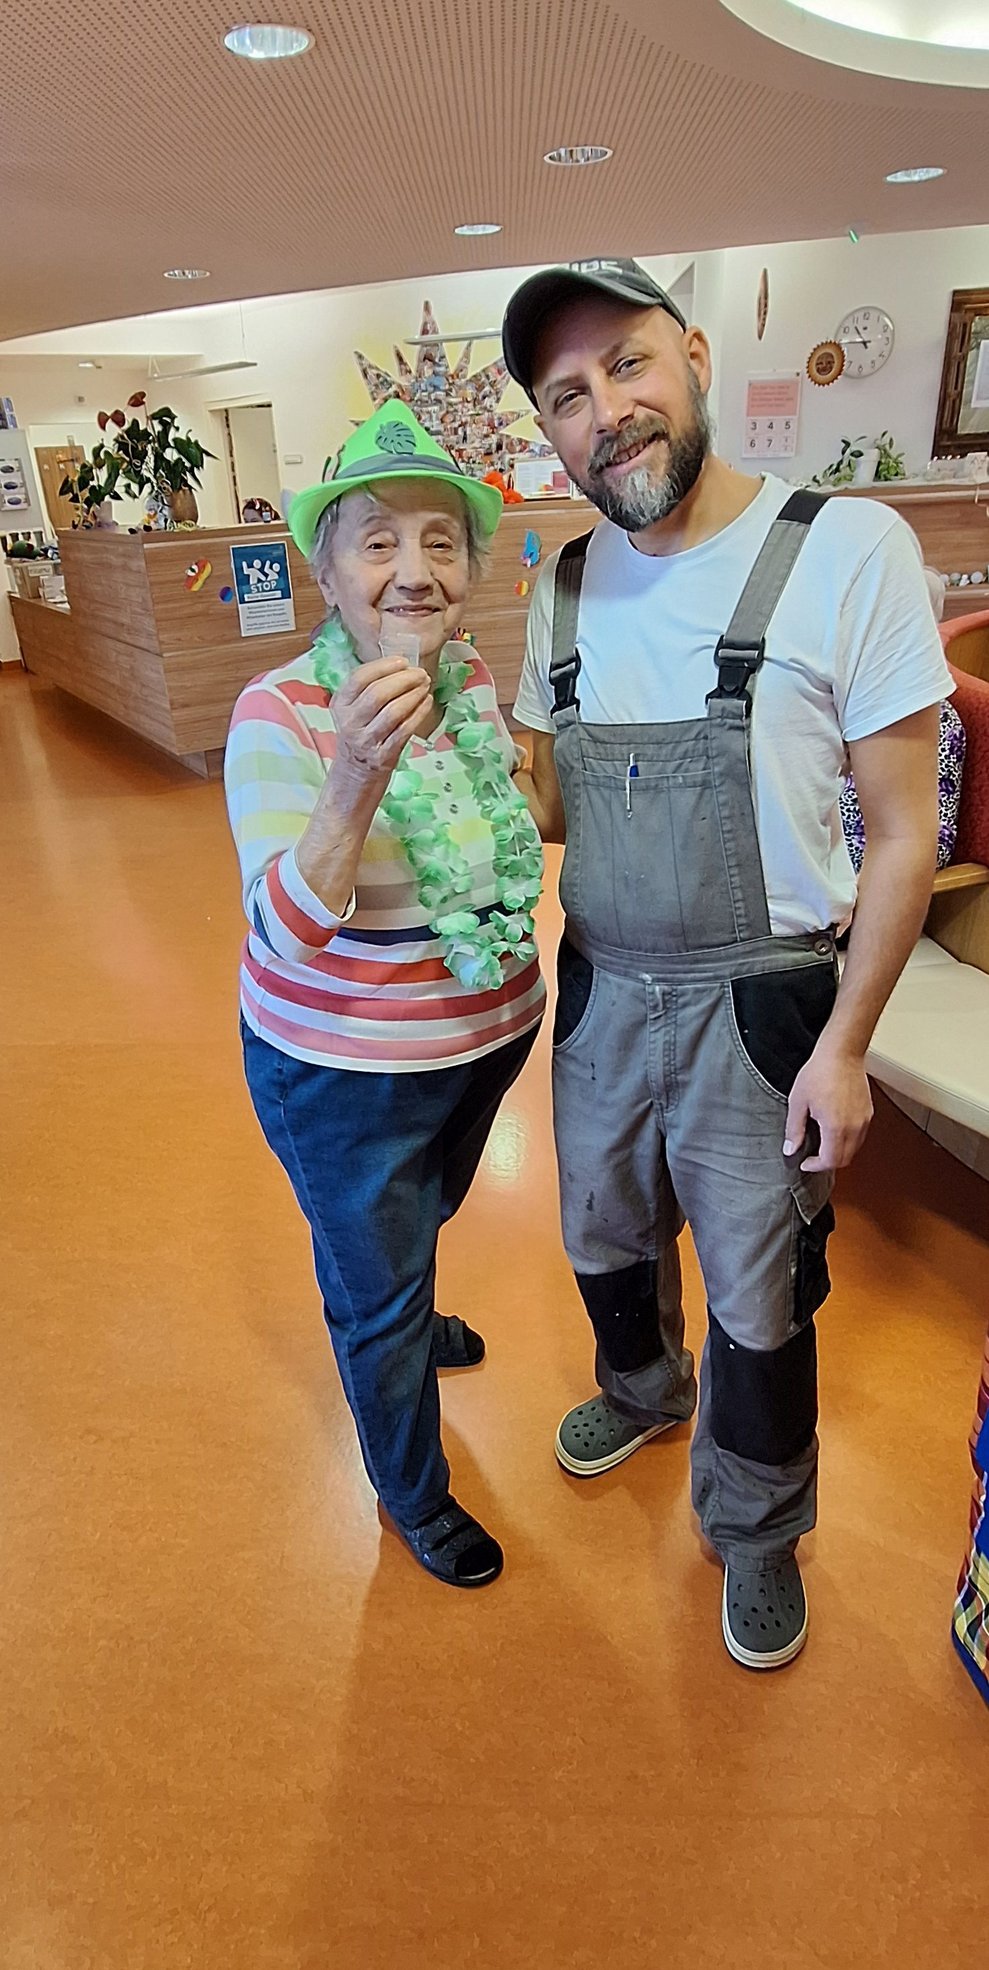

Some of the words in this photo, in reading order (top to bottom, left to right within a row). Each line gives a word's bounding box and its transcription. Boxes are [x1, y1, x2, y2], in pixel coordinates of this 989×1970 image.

[751, 422, 757, 430] 3
[767, 422, 774, 430] 4
[785, 421, 791, 430] 5
[750, 439, 756, 447] 6
[767, 439, 773, 447] 7
[250, 581, 277, 593] STOP
